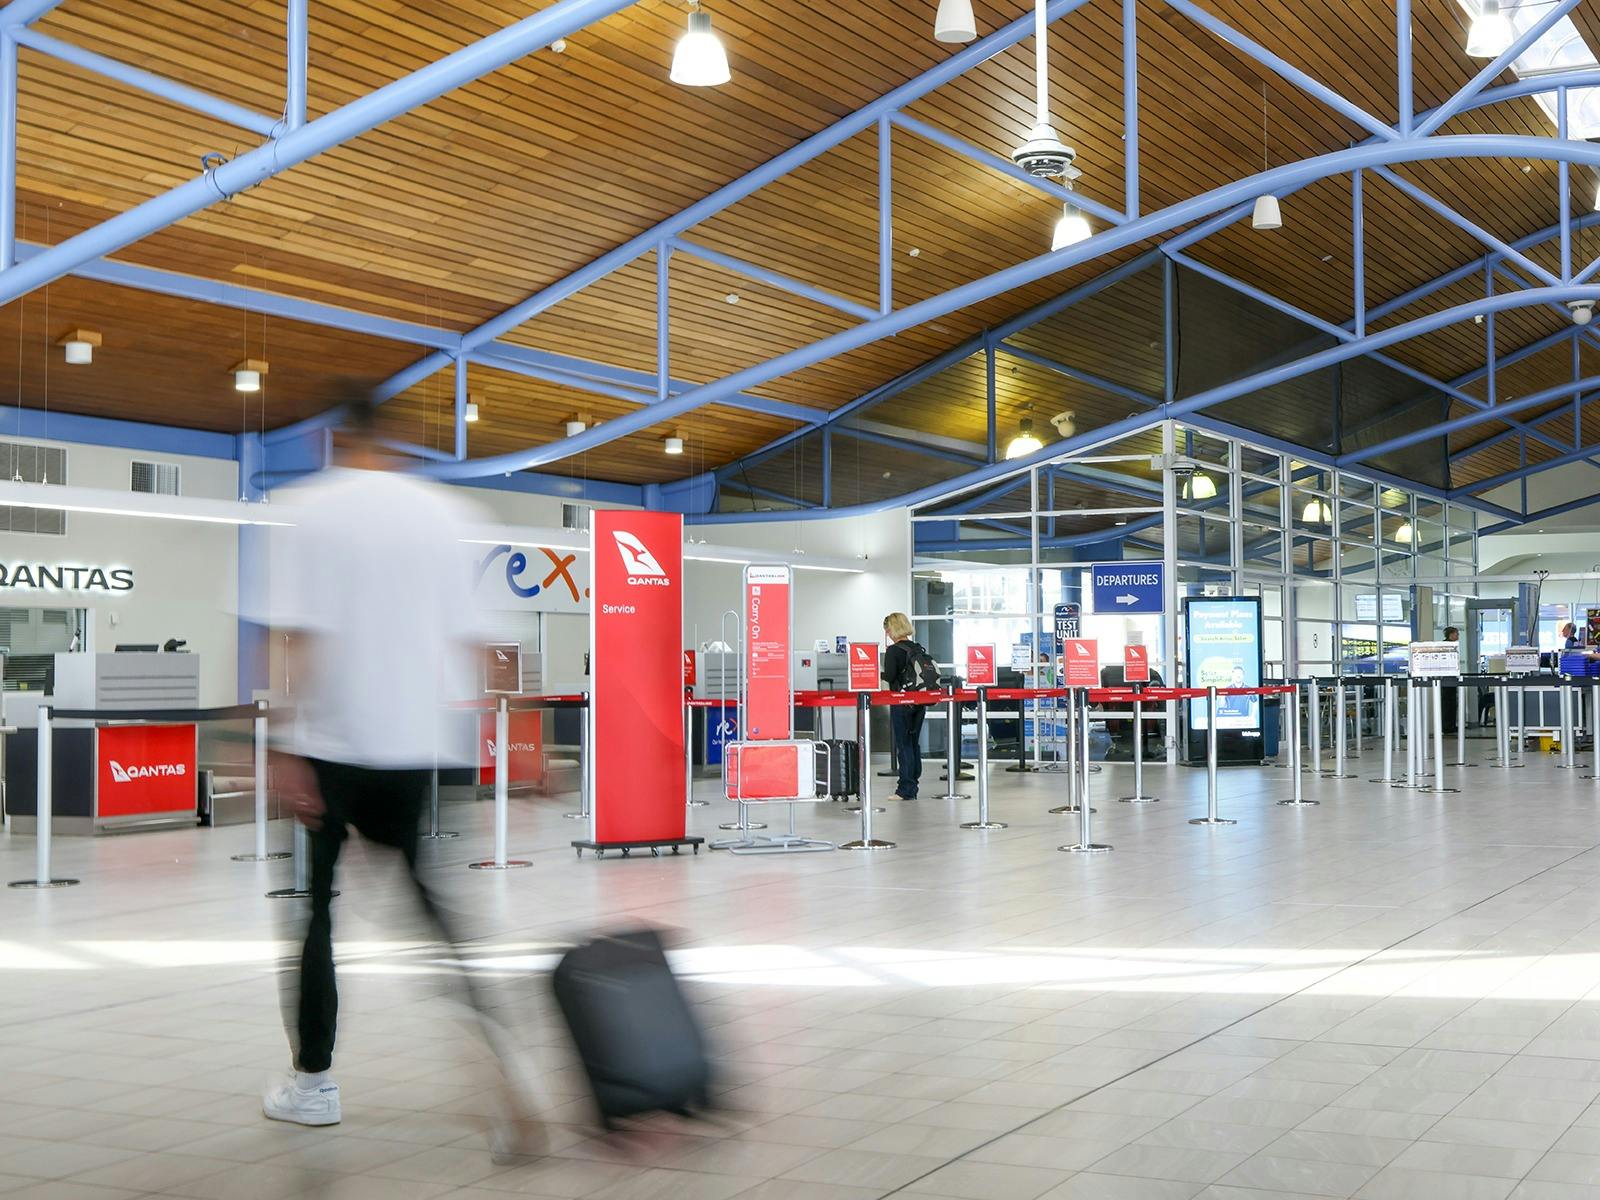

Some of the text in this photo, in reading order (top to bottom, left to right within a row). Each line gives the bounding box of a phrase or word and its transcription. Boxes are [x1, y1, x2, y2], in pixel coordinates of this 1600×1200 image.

[627, 577, 670, 586] QANTAS
[1096, 574, 1159, 586] DEPARTURES
[602, 604, 636, 614] Service
[750, 597, 761, 639] Carry On
[1057, 620, 1077, 630] TEST
[1056, 630, 1078, 639] UNIT
[127, 763, 186, 778] QANTAS
